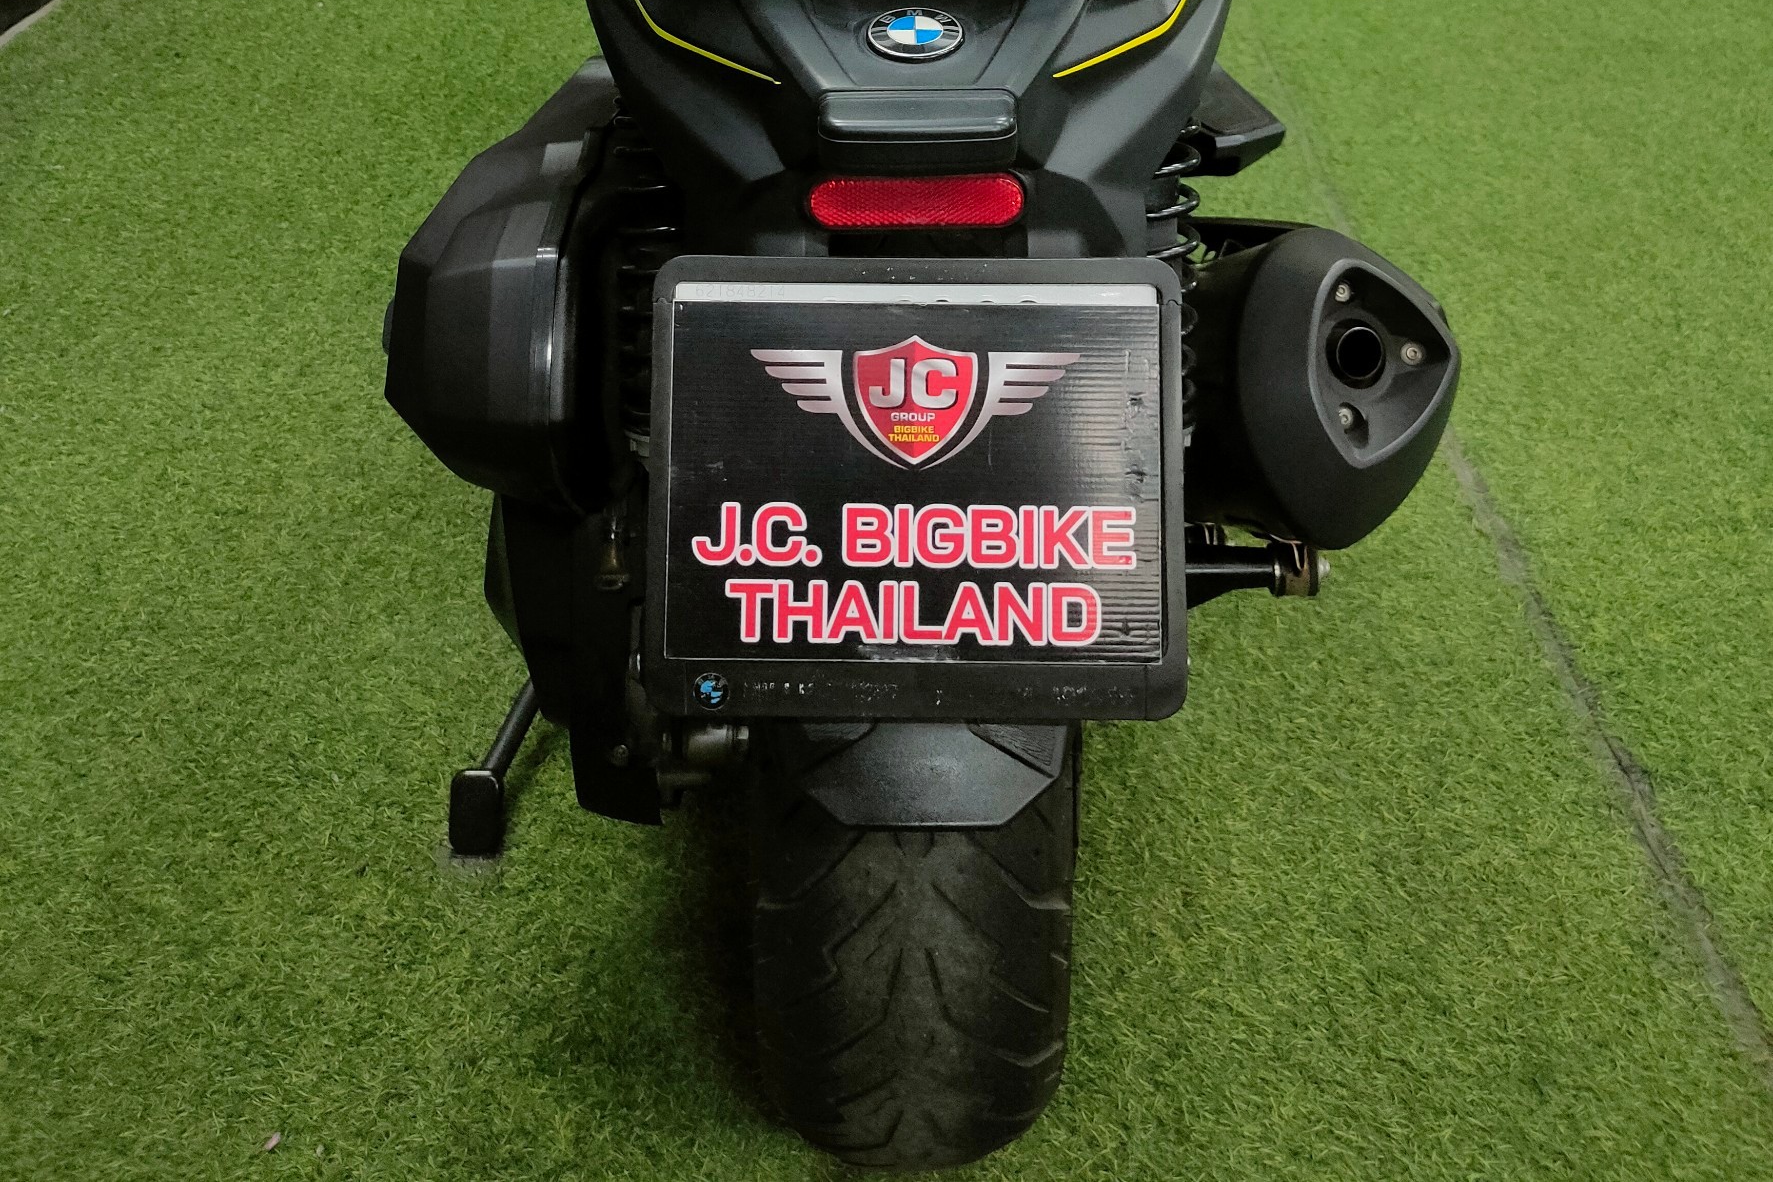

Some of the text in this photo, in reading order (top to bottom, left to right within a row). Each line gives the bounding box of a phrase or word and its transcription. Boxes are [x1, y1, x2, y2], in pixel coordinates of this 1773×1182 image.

[880, 9, 952, 24] BMW
[868, 358, 958, 410] JC
[890, 412, 936, 422] GROUP
[893, 425, 935, 433] BIGBIKE
[888, 433, 940, 443] THAILAND
[691, 501, 1137, 569] J.C. BIGBIKE
[725, 578, 1103, 647] THAILAND
